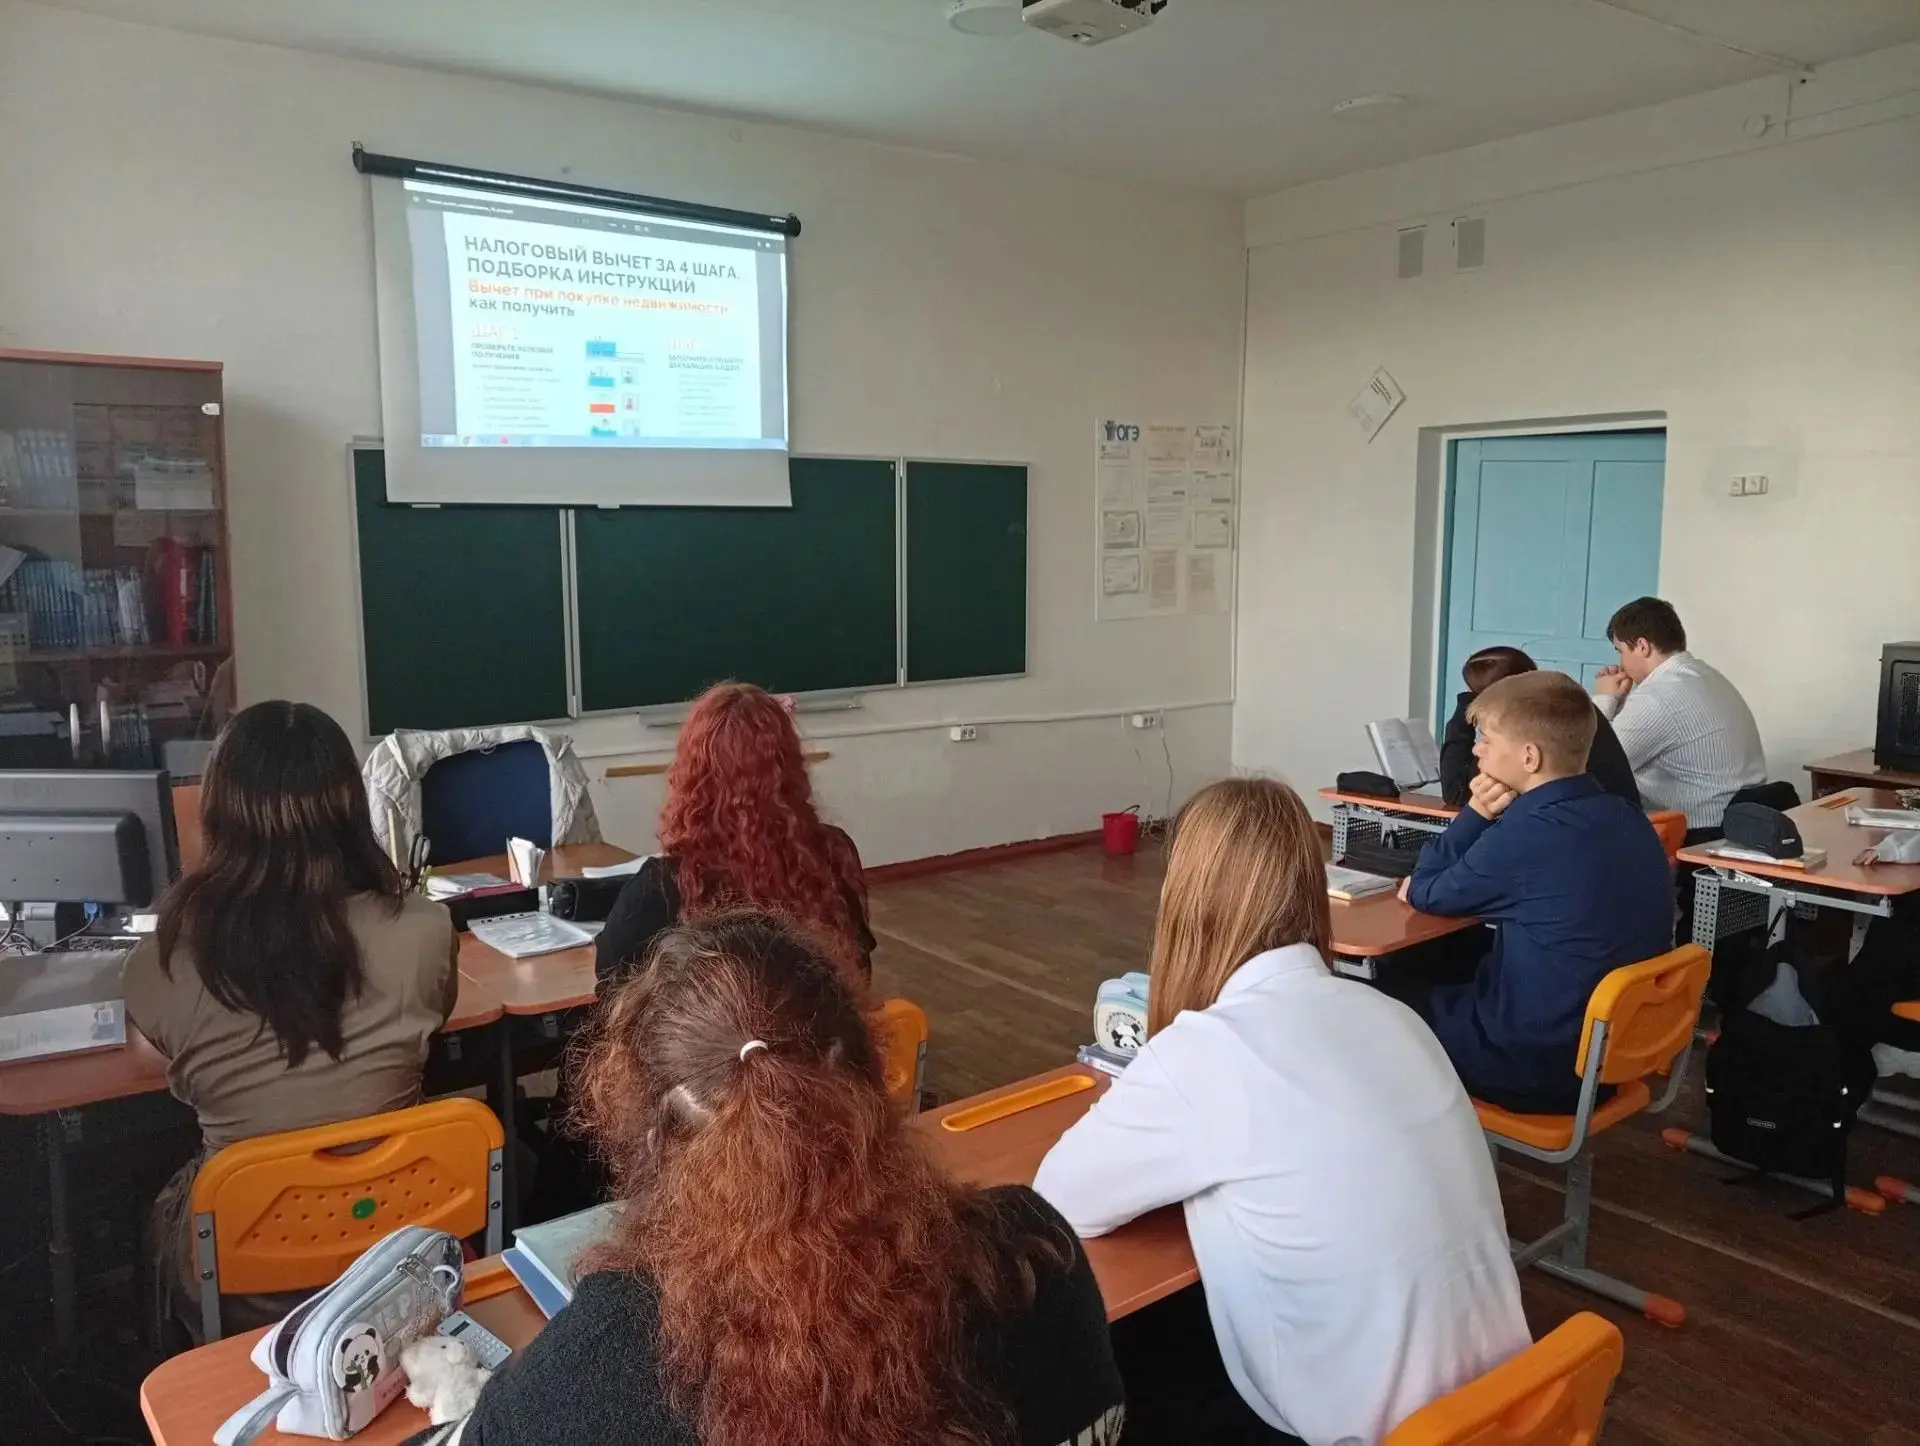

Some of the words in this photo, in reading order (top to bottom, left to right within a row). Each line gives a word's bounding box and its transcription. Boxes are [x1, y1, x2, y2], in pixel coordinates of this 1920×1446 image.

[464, 235, 588, 264] НАЛОГОВЫЙ
[592, 249, 652, 270] ВЫЧЕТ
[655, 258, 677, 273] ЗА
[679, 260, 689, 275] 4
[692, 262, 740, 280] ШАГА.
[466, 257, 574, 283] ПОДБОРКА
[577, 268, 696, 295] ИНСТРУКЦИЙ
[468, 279, 520, 297] Вычет
[524, 286, 554, 301] при
[557, 290, 620, 308] покупке
[469, 297, 498, 311] как
[502, 300, 576, 318] получить
[1116, 424, 1140, 442] ОГЭ
